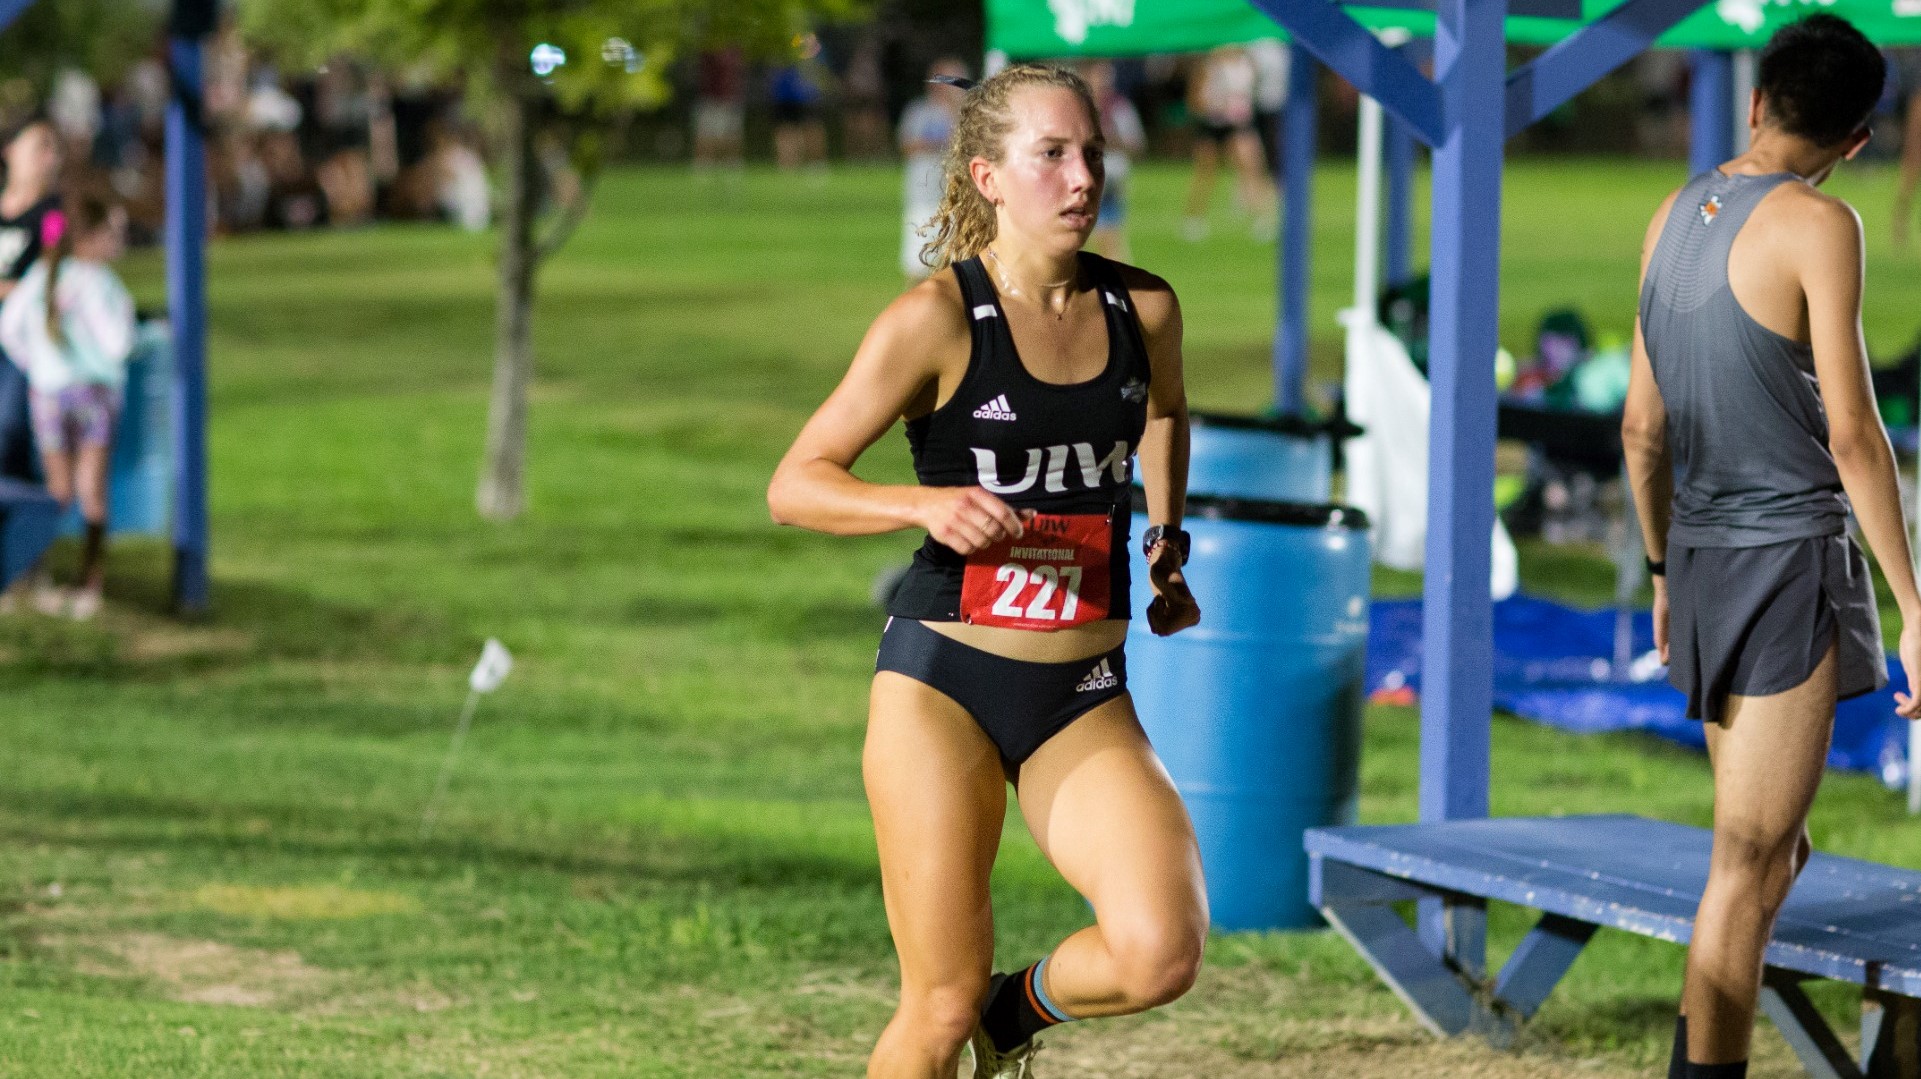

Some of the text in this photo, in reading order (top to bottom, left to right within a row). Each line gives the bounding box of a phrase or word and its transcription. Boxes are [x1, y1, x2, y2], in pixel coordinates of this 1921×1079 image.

[973, 408, 1017, 421] adidas
[970, 441, 1128, 494] UIW
[1009, 546, 1075, 561] INVITATIONAL
[991, 563, 1083, 621] 227
[1076, 675, 1118, 692] adidas
